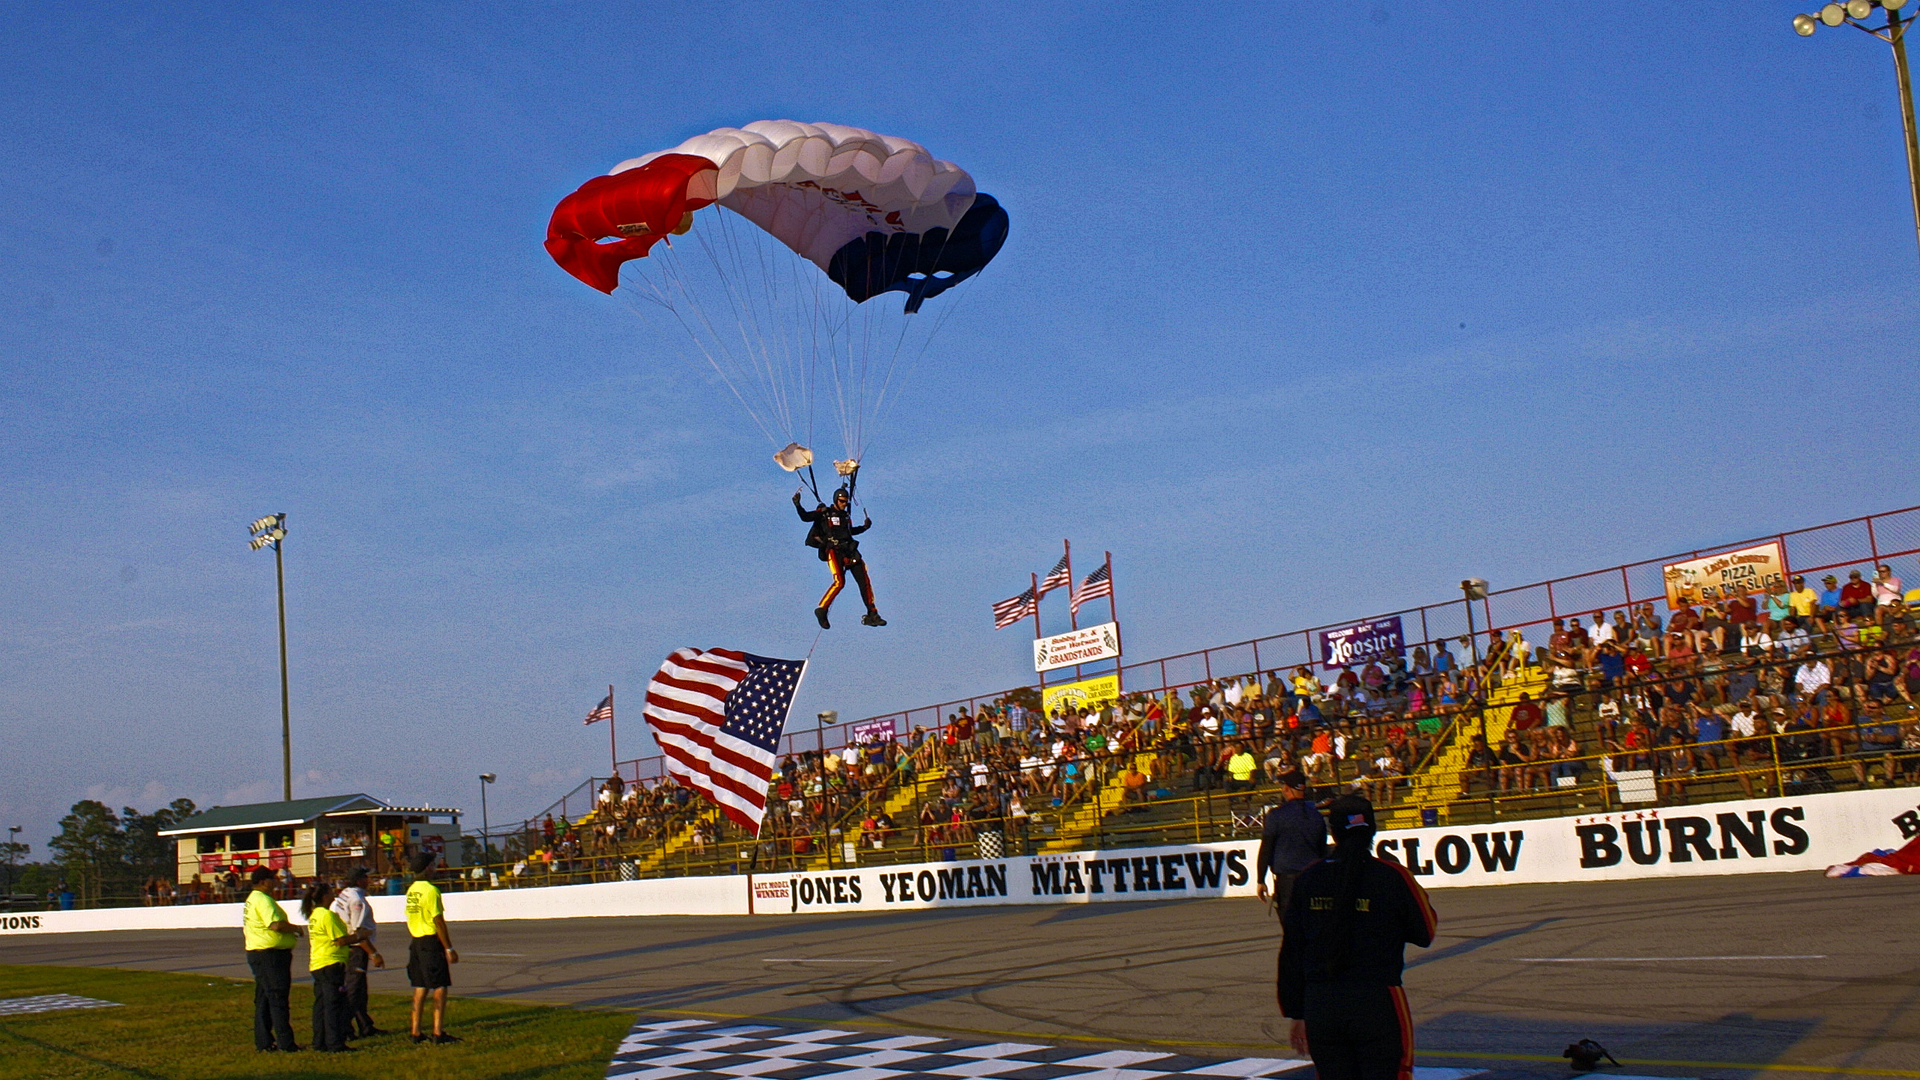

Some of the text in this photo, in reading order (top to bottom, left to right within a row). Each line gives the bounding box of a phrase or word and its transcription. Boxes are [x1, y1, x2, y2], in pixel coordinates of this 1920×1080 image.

[1721, 564, 1756, 581] PIZZA
[1746, 573, 1781, 590] SLICE
[1050, 646, 1103, 664] GRANDSTANDS
[1890, 804, 1920, 840] B
[790, 806, 1810, 913] JONES YEOMAN MATTHEWS SLOW BURNS
[754, 880, 789, 890] LATE MODEL
[756, 889, 789, 899] WINNERS
[0, 915, 40, 930] IONS
